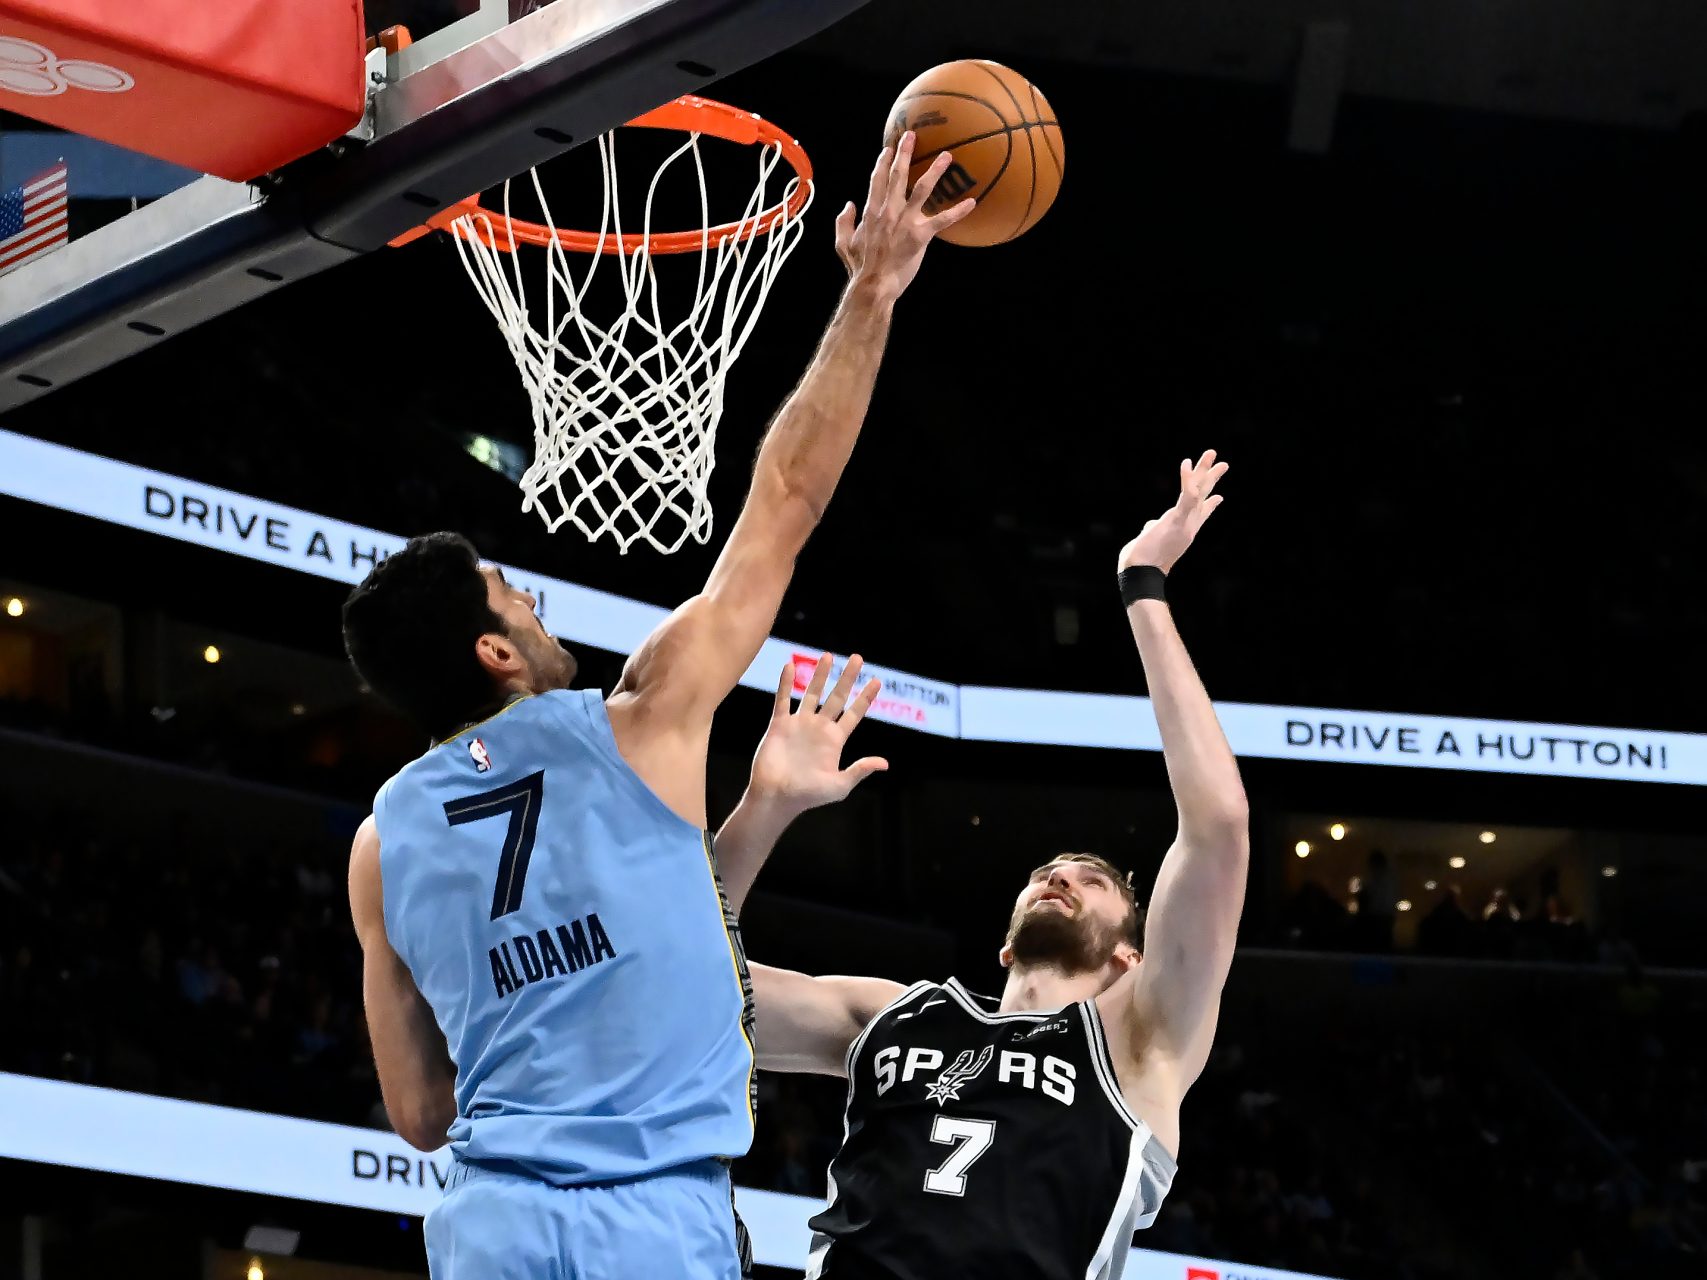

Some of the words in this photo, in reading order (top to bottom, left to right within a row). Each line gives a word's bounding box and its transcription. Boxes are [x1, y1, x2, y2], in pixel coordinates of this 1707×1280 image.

[144, 486, 291, 551] DRIVE
[306, 531, 333, 563] A
[1286, 720, 1420, 754] DRIVE
[1435, 731, 1462, 757] A
[1477, 733, 1668, 769] HUTTON!
[443, 769, 545, 921] 7
[488, 913, 617, 998] ALDAMA
[874, 1044, 1077, 1107] SPURS
[353, 1148, 449, 1191] DRIV
[923, 1114, 997, 1197] 7
